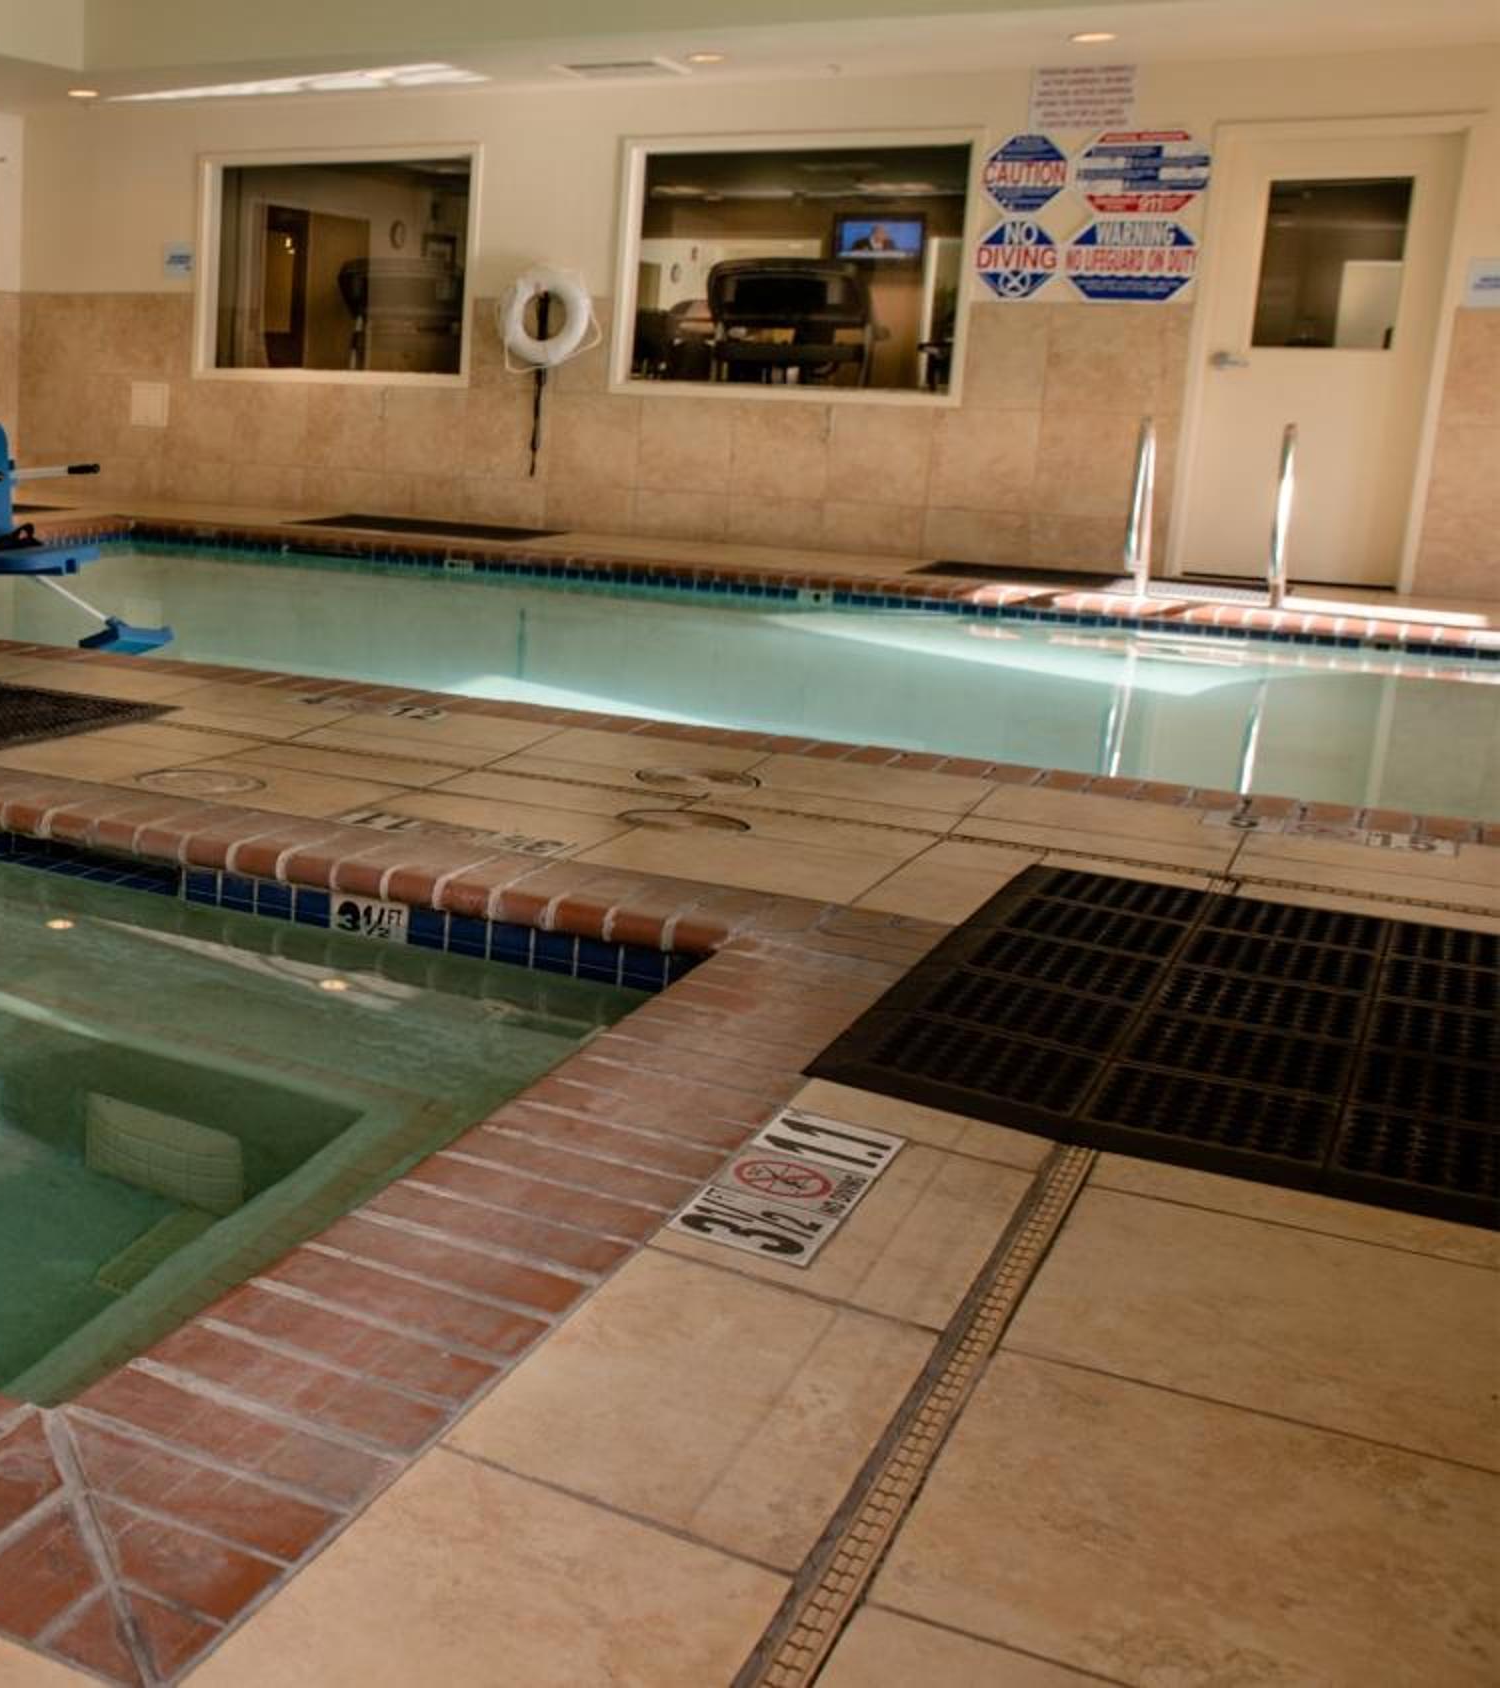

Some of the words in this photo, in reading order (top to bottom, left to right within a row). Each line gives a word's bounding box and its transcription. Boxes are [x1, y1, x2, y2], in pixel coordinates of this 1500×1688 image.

[983, 161, 1067, 185] CAUTION
[1003, 222, 1037, 245] NO
[1096, 222, 1176, 245] WARNING
[976, 247, 1057, 269] DIVING
[1066, 250, 1081, 270] NO
[1084, 249, 1142, 270] LIFEGUARD
[1148, 249, 1165, 270] ON
[1168, 248, 1197, 270] DUTY
